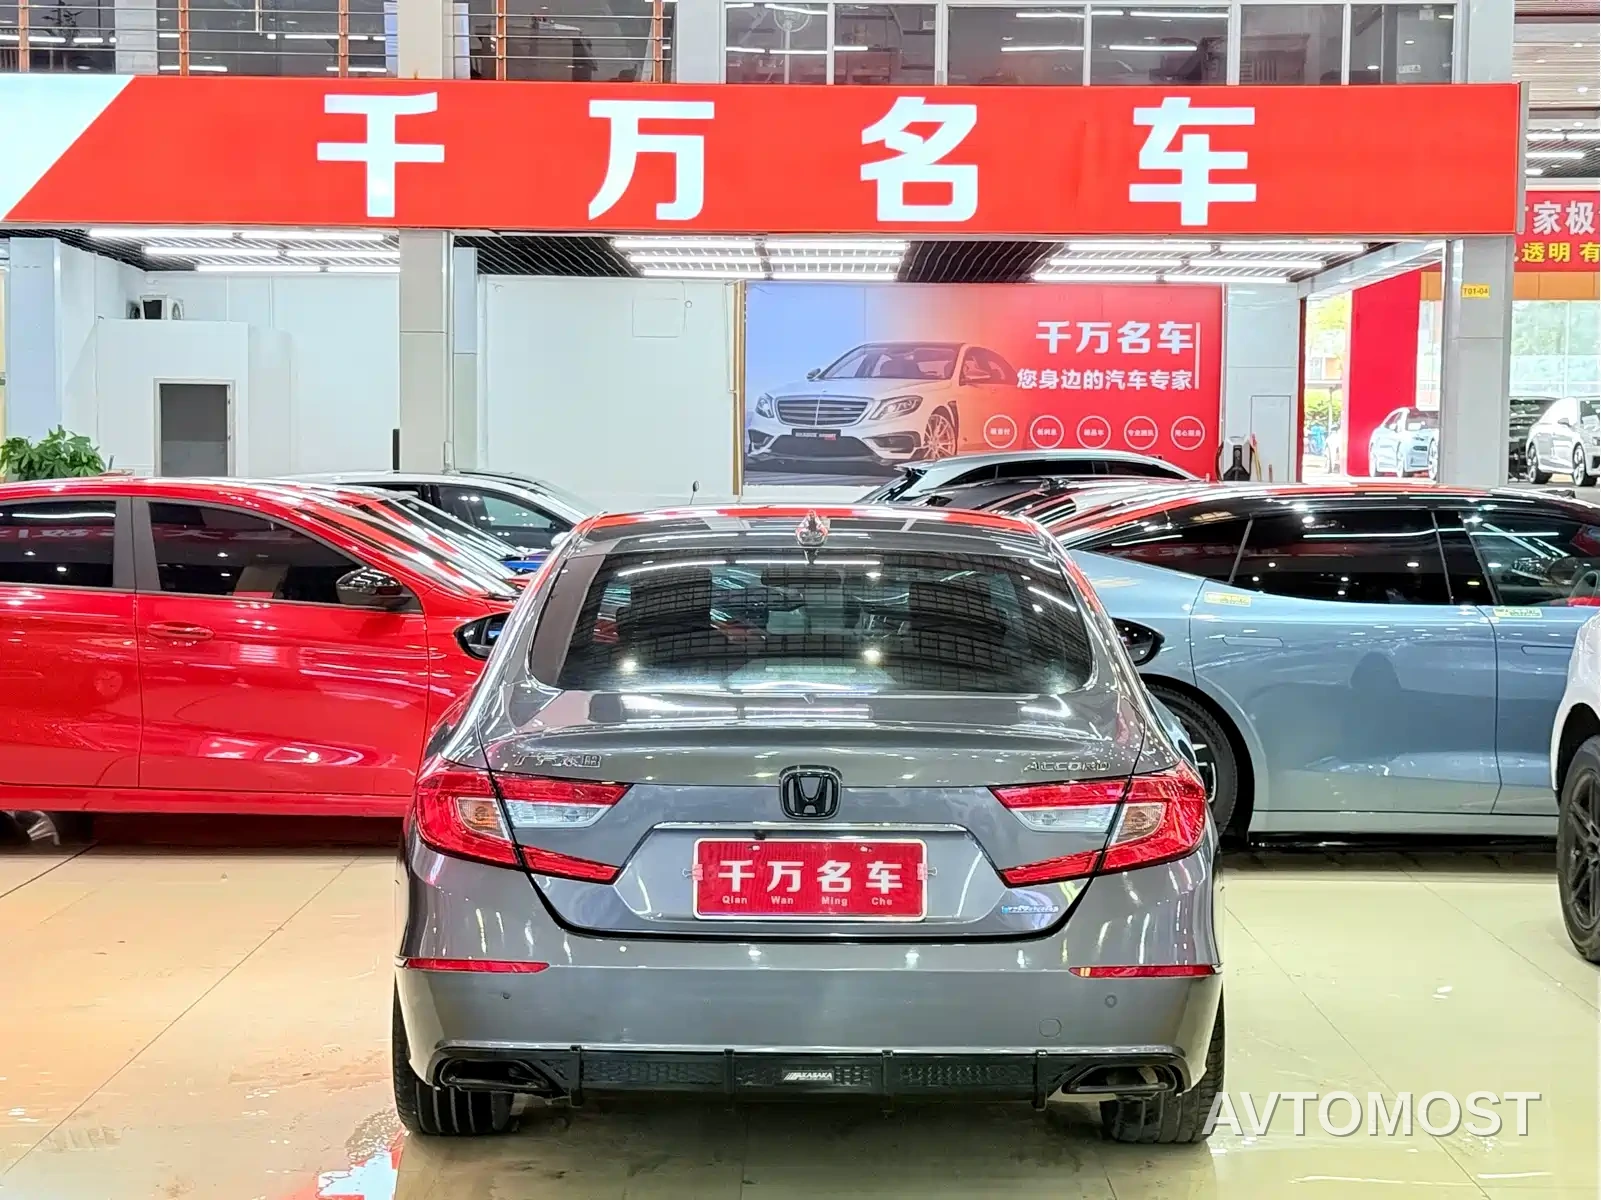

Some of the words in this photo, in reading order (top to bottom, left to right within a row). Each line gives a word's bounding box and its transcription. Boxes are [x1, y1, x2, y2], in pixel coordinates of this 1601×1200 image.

[316, 91, 1257, 225] 千万名车
[1525, 200, 1601, 235] 家极
[1514, 242, 1571, 263] 透明
[1036, 321, 1194, 354] 千万名车
[1016, 368, 1193, 391] 您身边的汽车专家
[1023, 761, 1111, 772] ACCORD
[718, 860, 903, 895] 千万名车
[722, 895, 748, 905] Qian
[771, 895, 794, 905] Wan
[821, 895, 848, 907] Ming
[871, 896, 893, 906] Che
